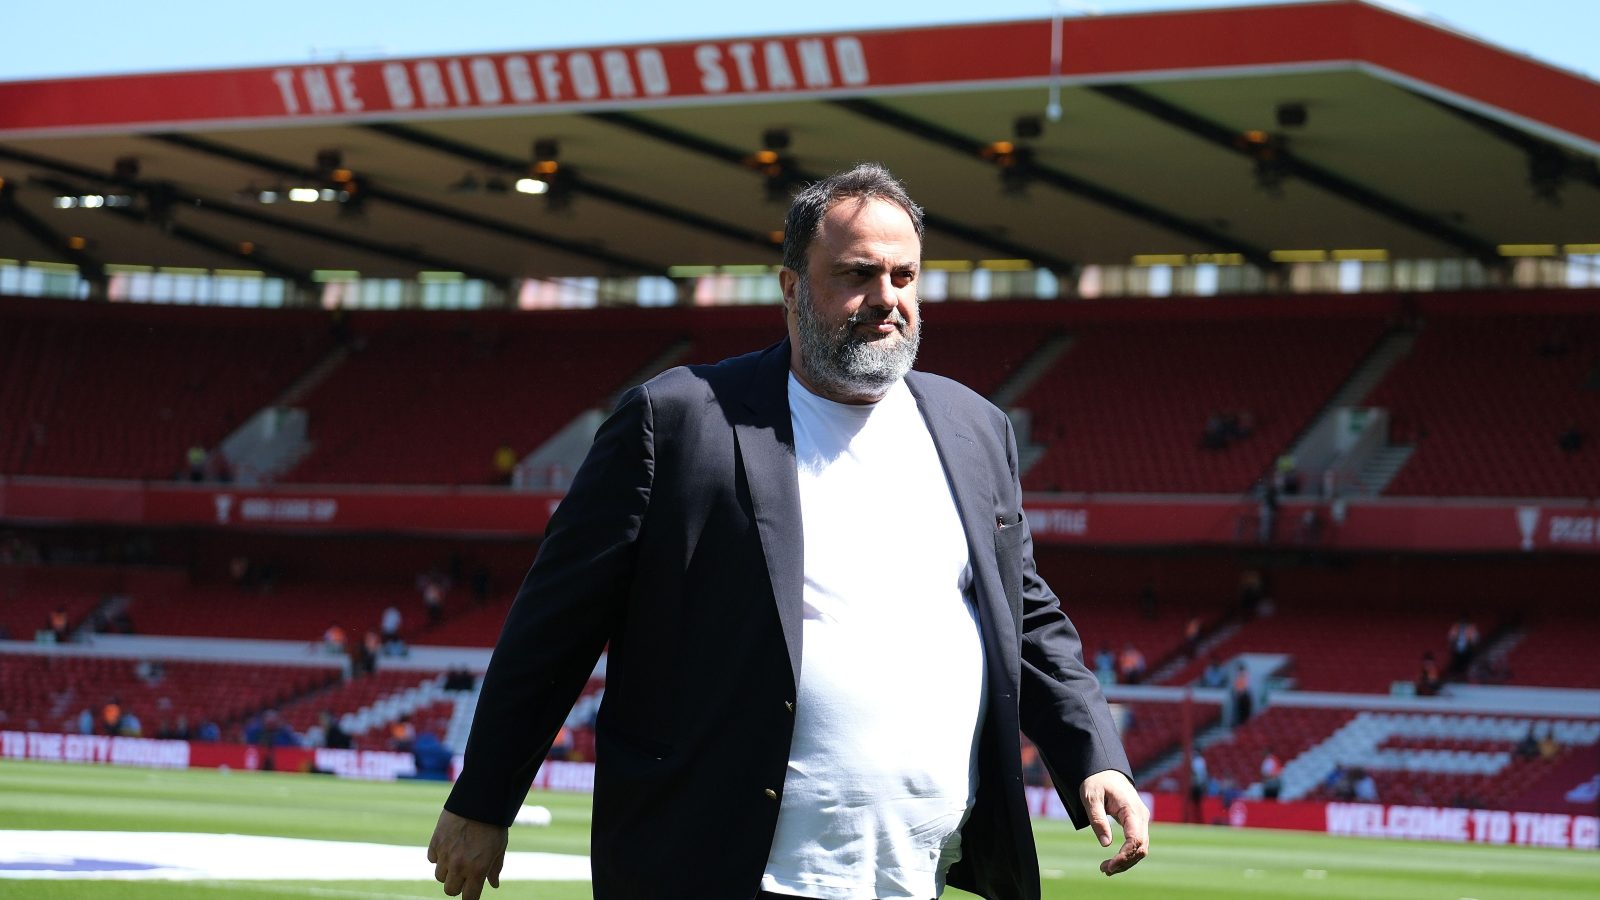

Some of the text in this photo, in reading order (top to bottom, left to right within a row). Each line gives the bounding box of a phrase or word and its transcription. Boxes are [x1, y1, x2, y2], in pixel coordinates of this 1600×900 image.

[272, 36, 869, 115] THE BRIDGFORD STAND
[2, 730, 26, 759] TO
[28, 732, 62, 762] THE
[64, 734, 110, 765] CITY
[1326, 802, 1471, 841] WELCOME
[1472, 809, 1510, 845] TO
[1512, 811, 1570, 848] THE
